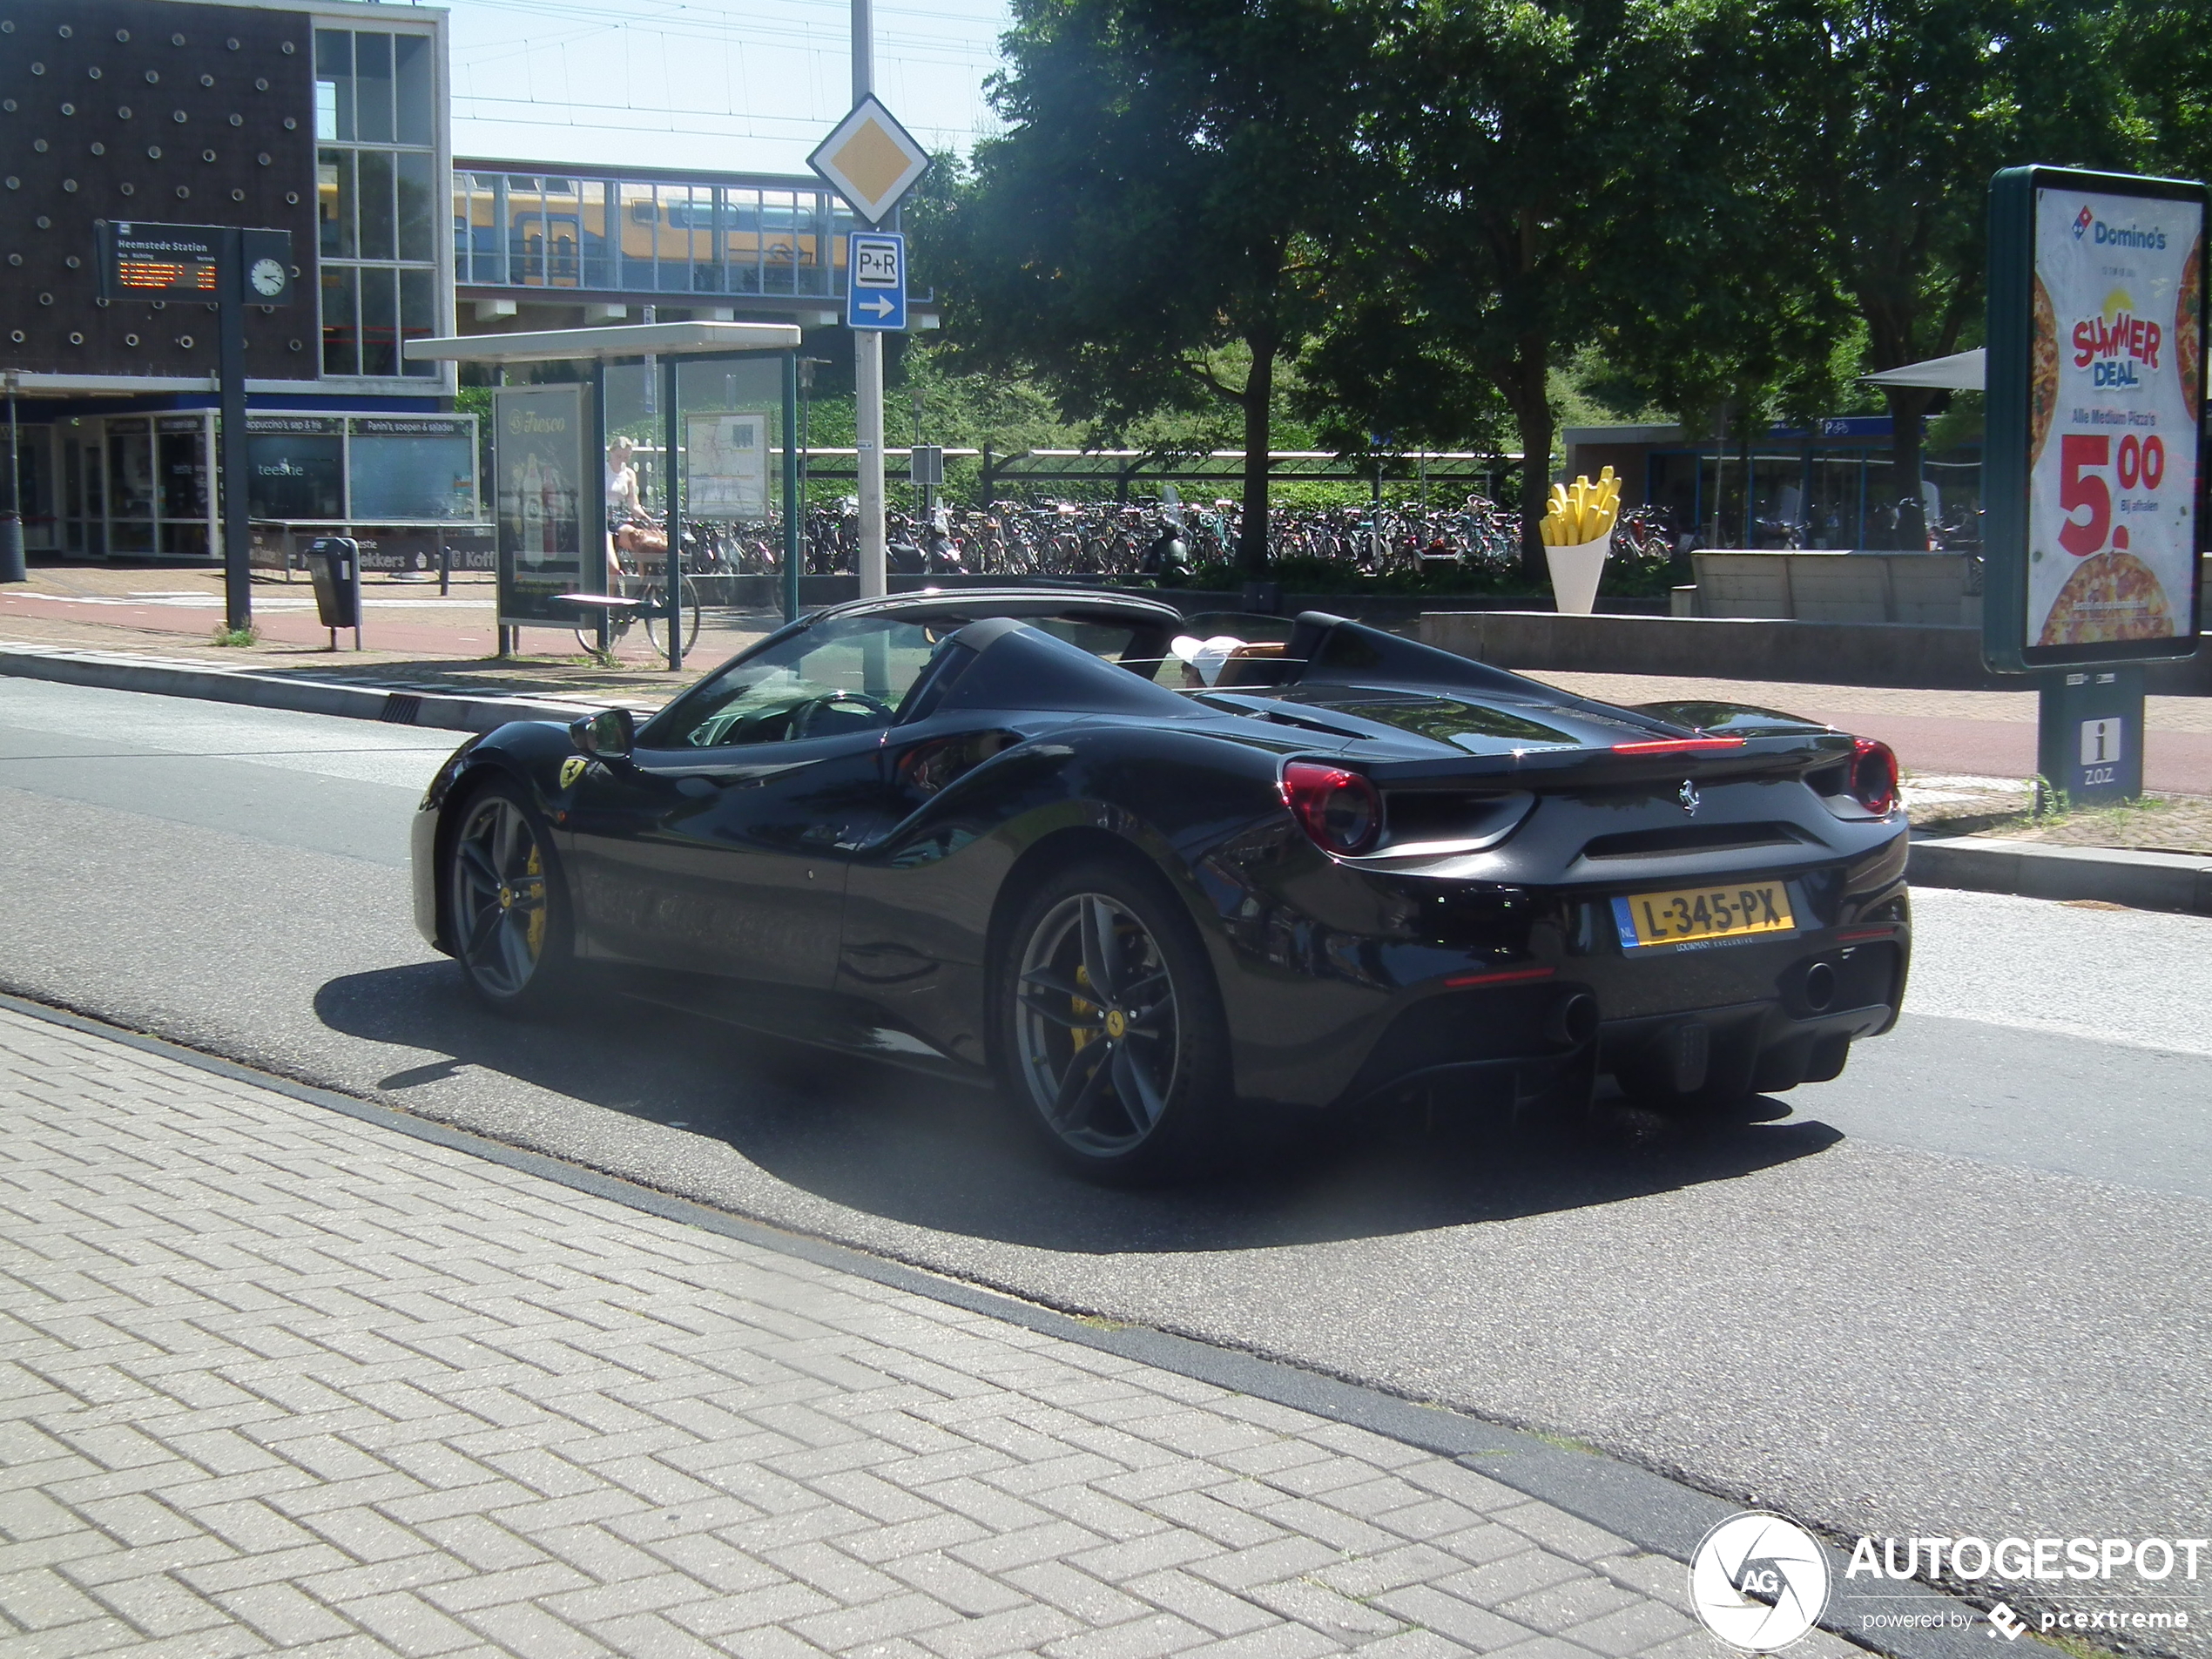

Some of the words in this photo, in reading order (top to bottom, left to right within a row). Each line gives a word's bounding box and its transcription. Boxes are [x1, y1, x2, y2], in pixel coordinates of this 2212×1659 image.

[2095, 221, 2167, 250] Domino's
[118, 239, 171, 251] Heemstede
[172, 241, 208, 253] Station
[860, 253, 895, 274] P+R
[2073, 312, 2161, 369] SUMMER
[2094, 361, 2139, 388] DEAL
[524, 411, 565, 433] Fresco
[2072, 408, 2089, 424] Alle
[2091, 409, 2126, 425] Medium
[2128, 410, 2156, 427] Pizza's
[2121, 499, 2131, 514] Bij
[2132, 499, 2158, 512] afhalen
[359, 540, 377, 549] estie
[360, 552, 405, 567] ekkers
[465, 551, 495, 567] Koff
[1621, 928, 1635, 939] NL
[1643, 888, 1782, 937] L-345-PX
[1675, 941, 1710, 953] LOUWMAN
[1713, 937, 1753, 948] EXCLUSIVE
